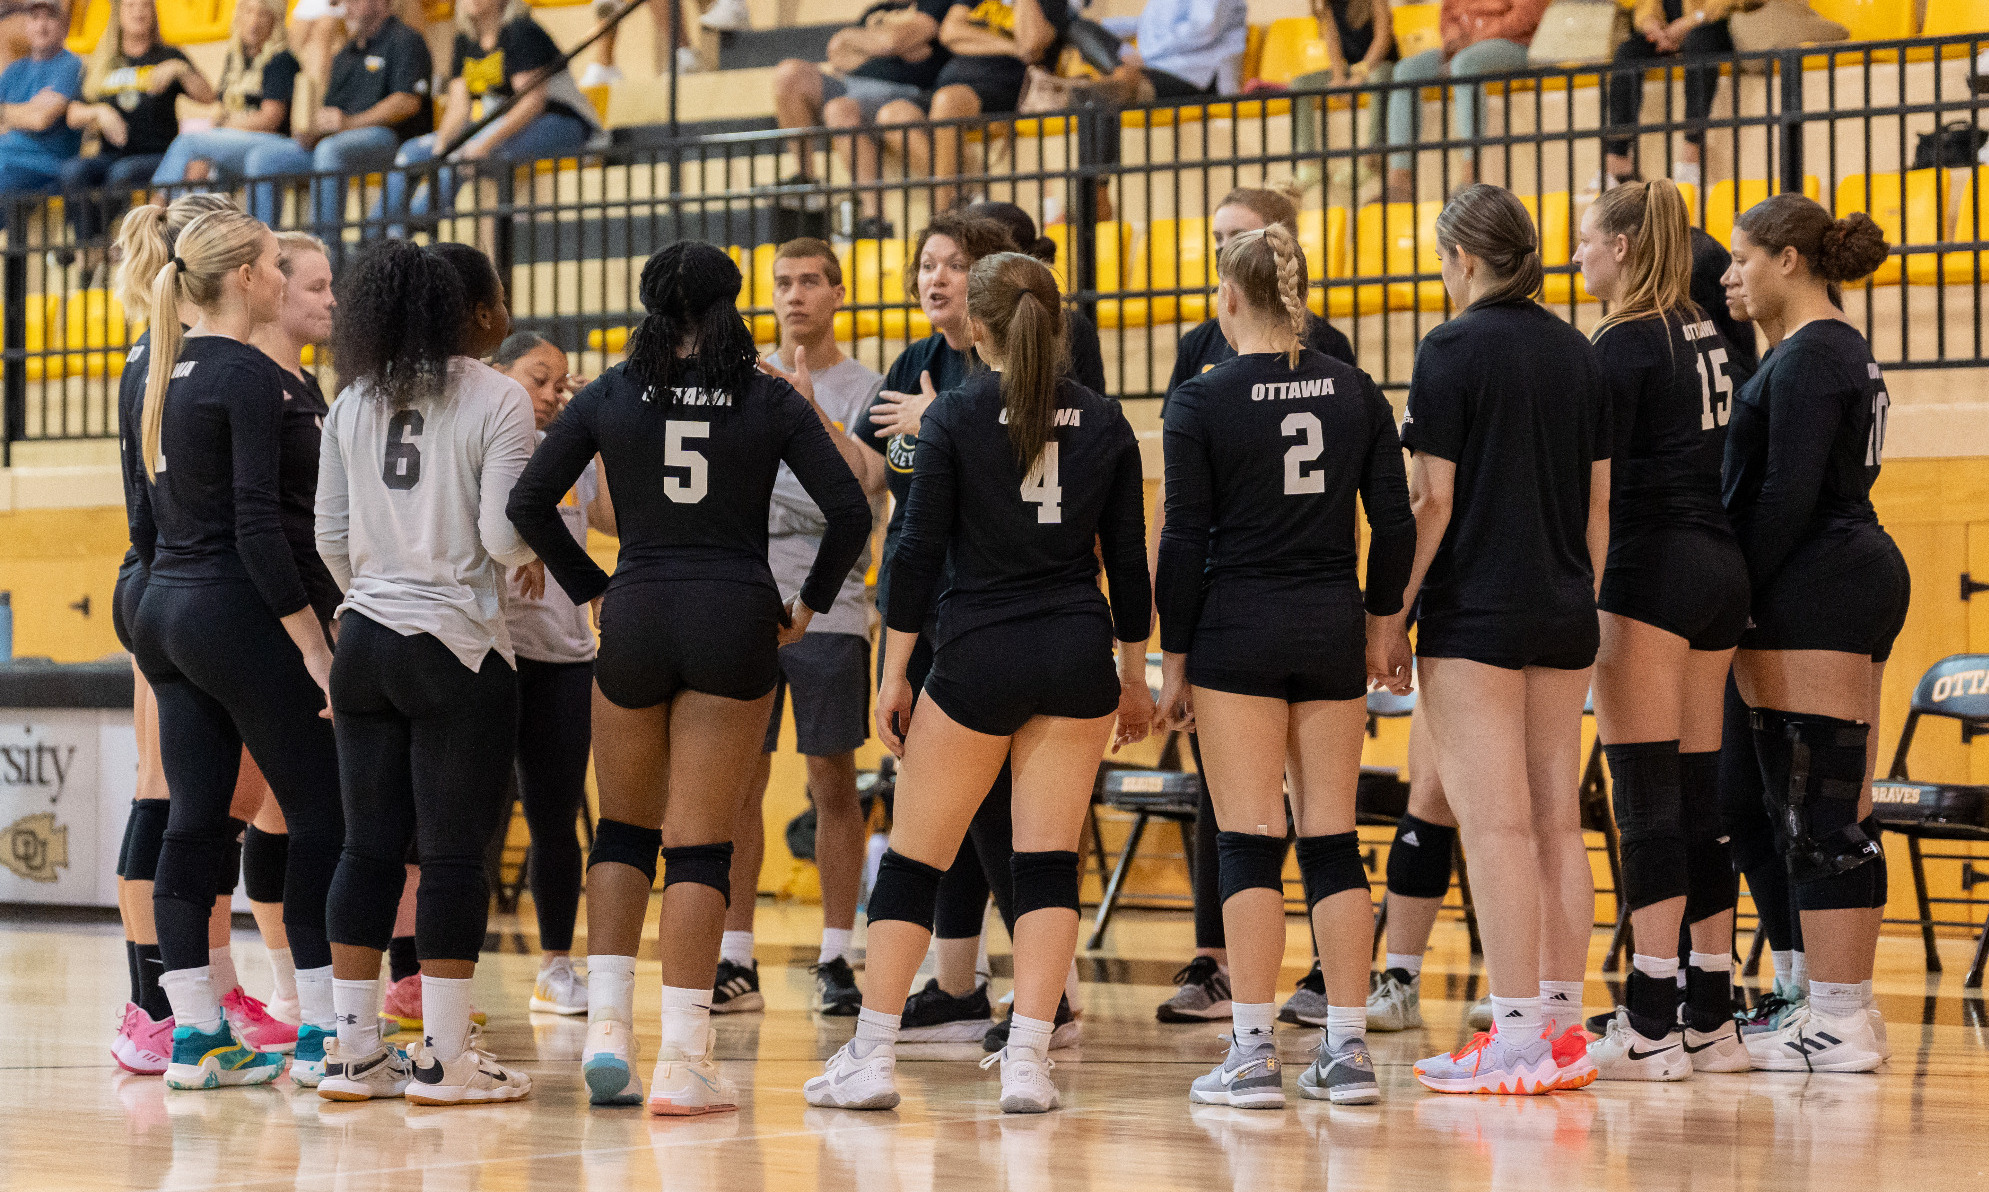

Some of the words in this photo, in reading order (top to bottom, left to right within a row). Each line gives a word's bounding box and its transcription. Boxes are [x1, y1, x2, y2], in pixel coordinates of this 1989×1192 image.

[1682, 320, 1718, 341] OTTAWA
[1251, 378, 1335, 401] OTTAWA
[1696, 348, 1733, 430] 15
[382, 409, 424, 490] 6
[663, 420, 710, 504] 5
[1020, 441, 1062, 524] 4
[1280, 412, 1325, 495] 2
[0, 725, 76, 804] sity
